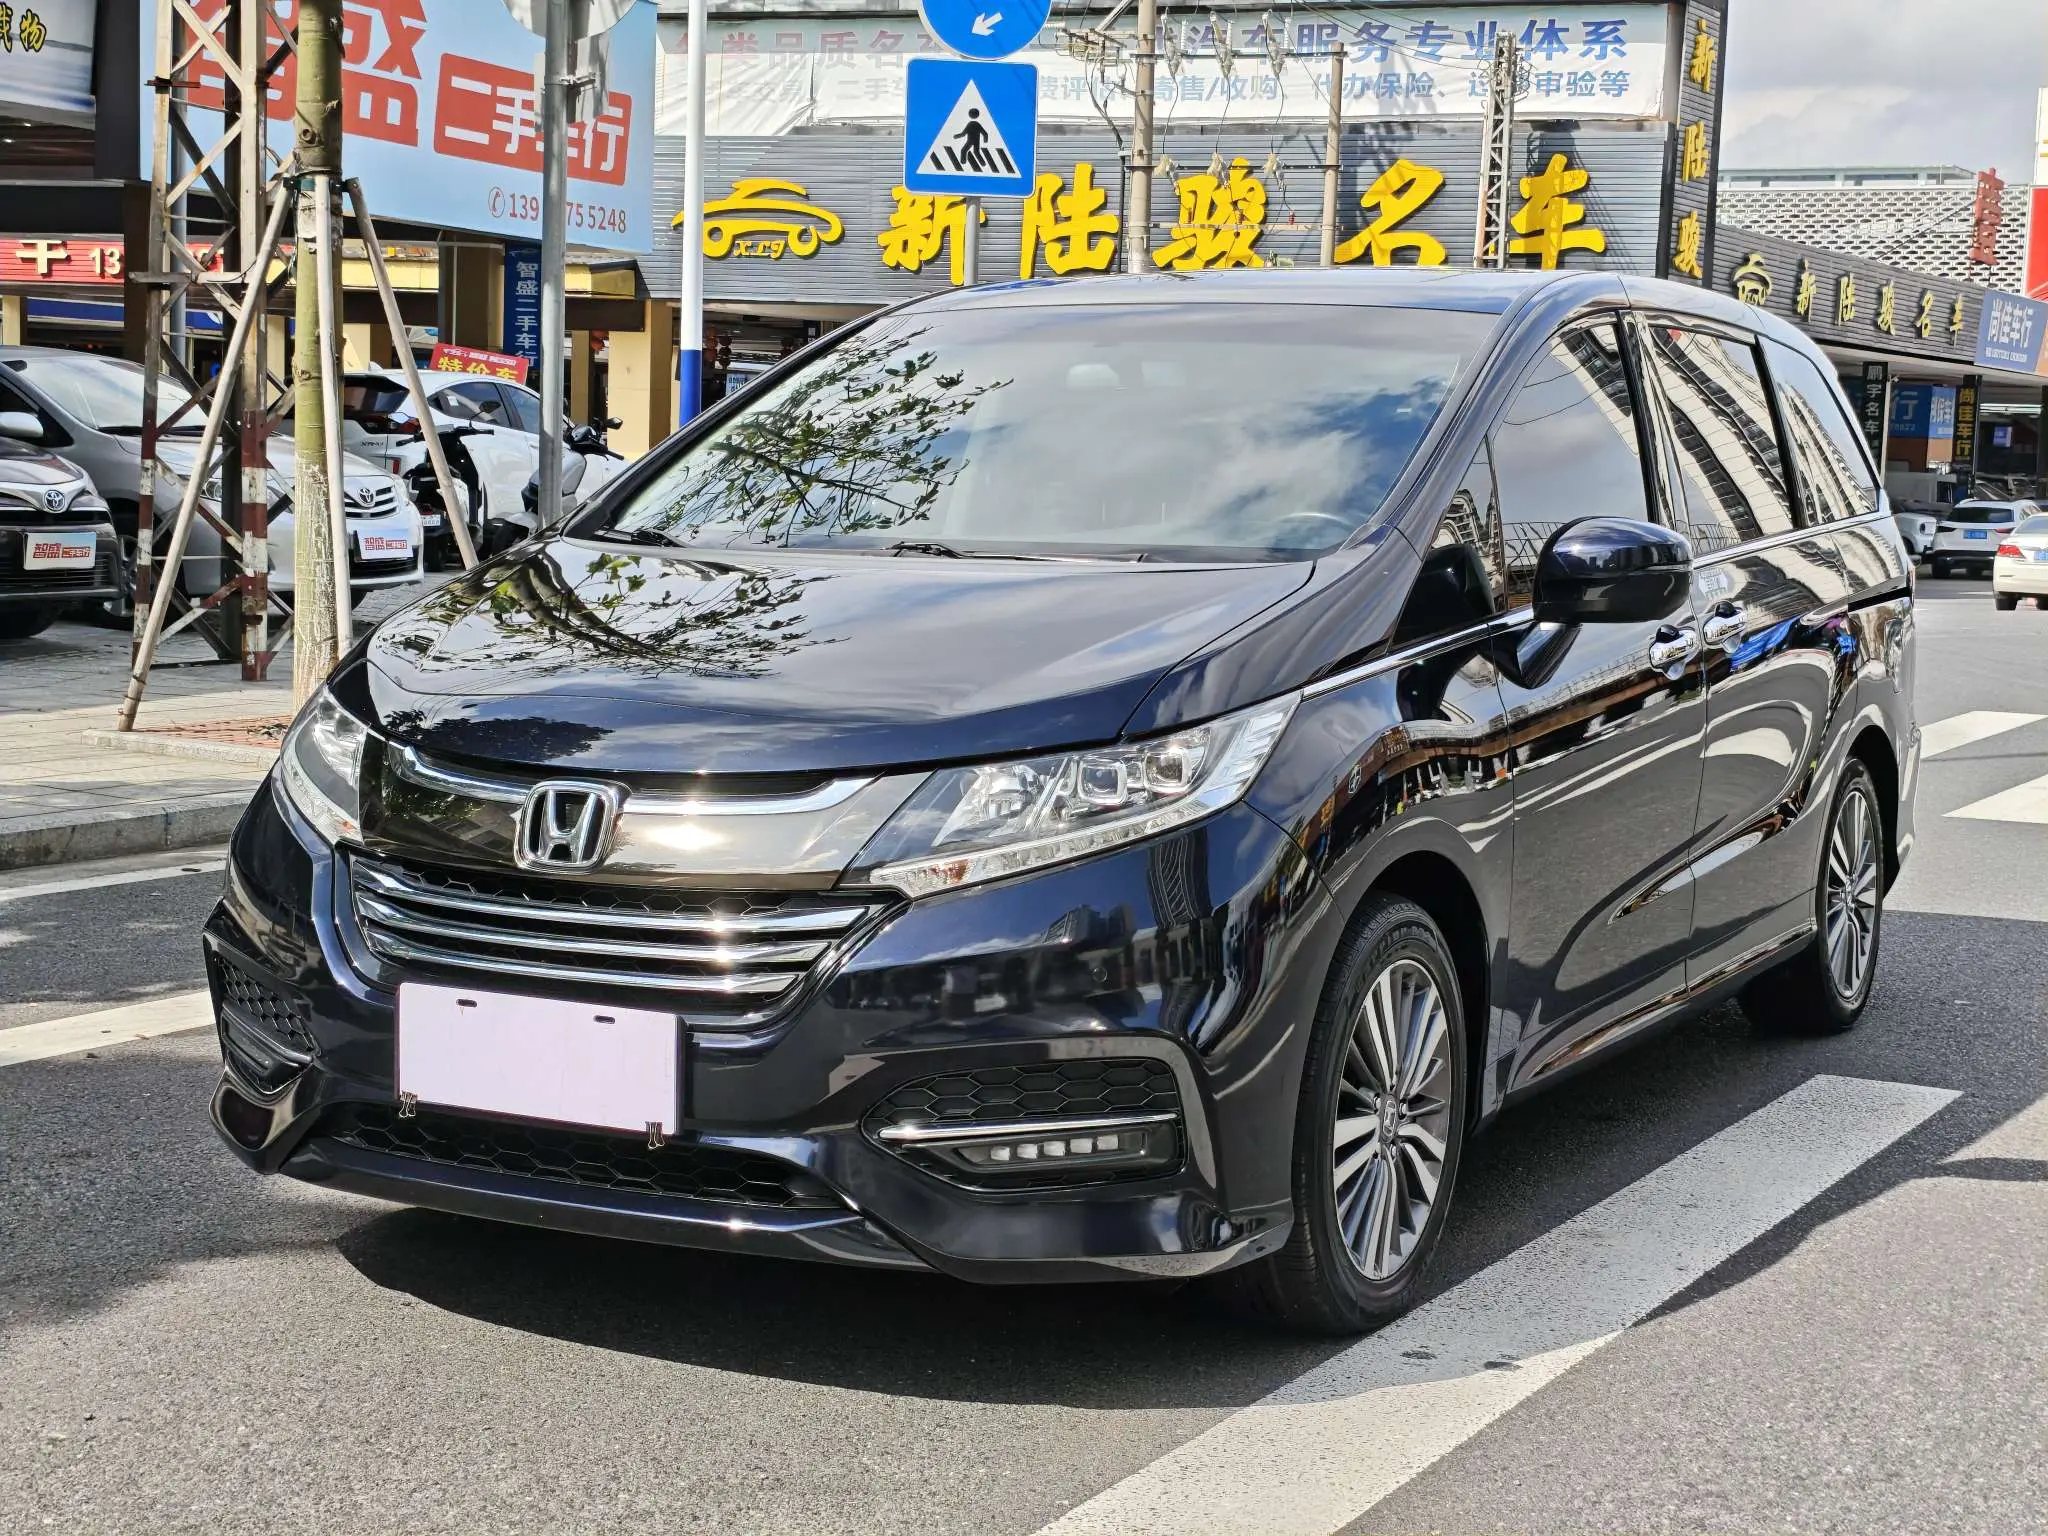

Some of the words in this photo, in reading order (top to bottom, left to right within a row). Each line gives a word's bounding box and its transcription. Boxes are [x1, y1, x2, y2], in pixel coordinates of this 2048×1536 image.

[445, 75, 624, 172] 二手行
[509, 192, 627, 234] 139755248
